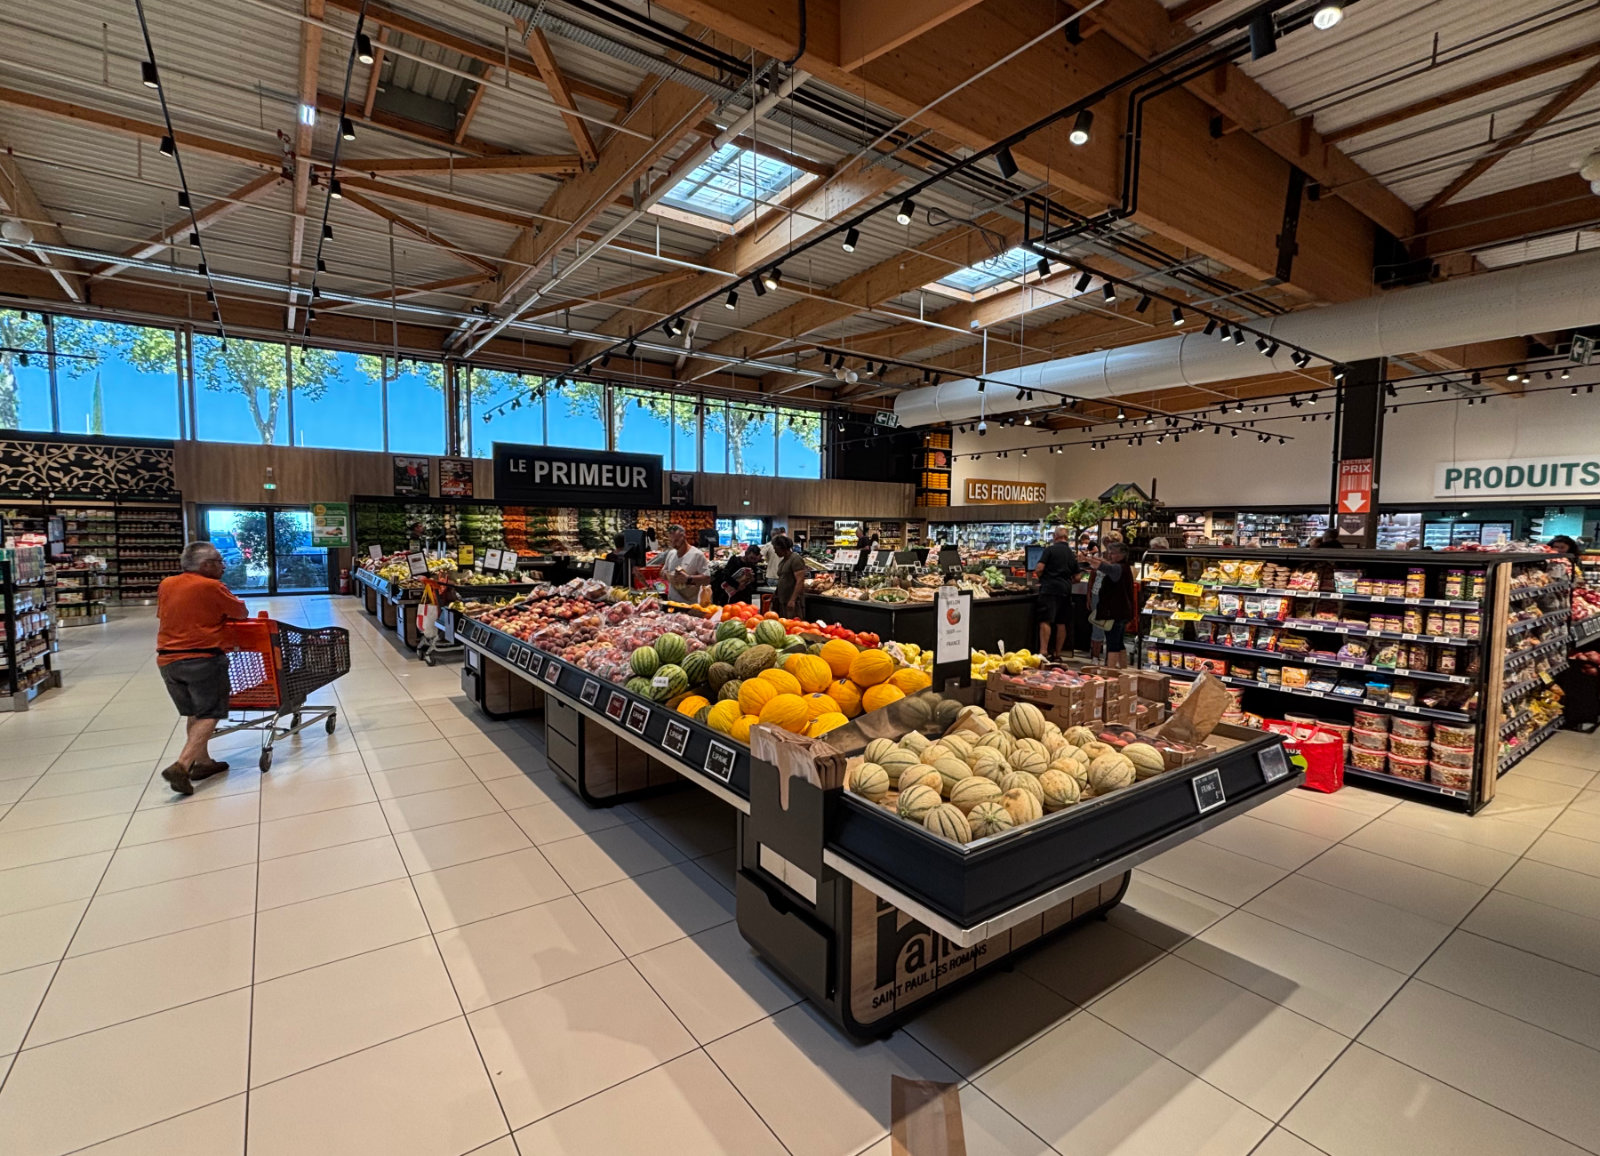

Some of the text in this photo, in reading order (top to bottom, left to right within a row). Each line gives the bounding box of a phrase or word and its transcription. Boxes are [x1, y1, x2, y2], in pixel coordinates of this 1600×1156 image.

[509, 459, 648, 488] LE PRIMEUR
[1342, 464, 1371, 474] PRIX
[1444, 461, 1600, 490] PRODUITS
[968, 483, 1046, 502] LES FROMAGES
[872, 943, 987, 1009] SAINT PAUL LES ROMANS
